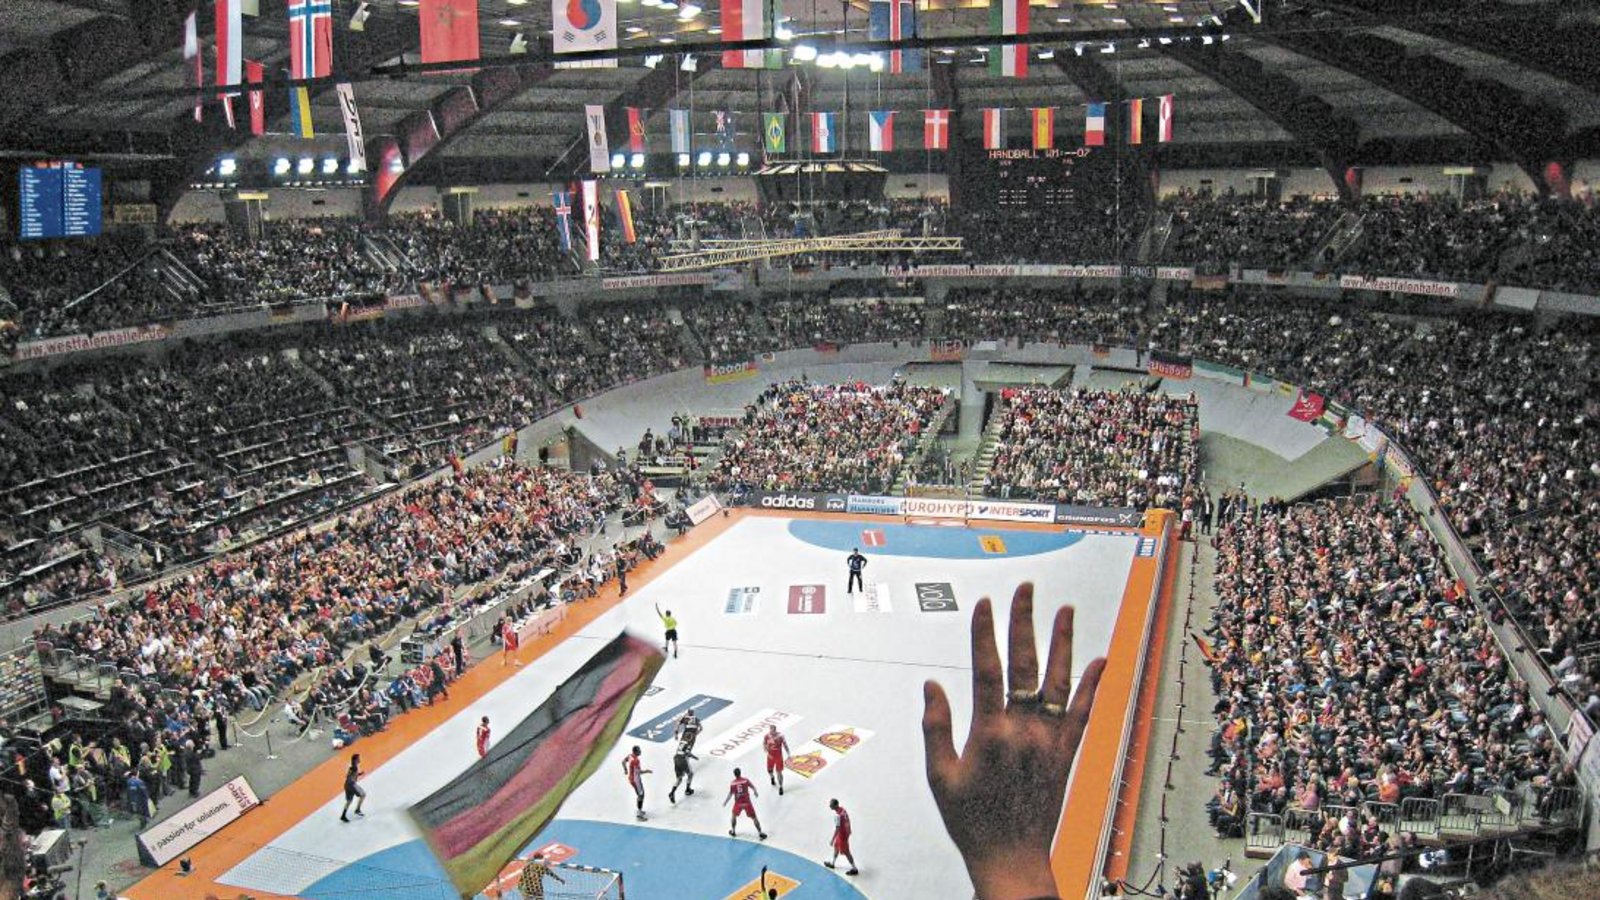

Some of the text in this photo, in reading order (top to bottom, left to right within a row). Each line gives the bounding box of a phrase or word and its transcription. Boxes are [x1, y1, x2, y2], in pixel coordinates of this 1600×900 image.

[762, 494, 815, 509] adidas
[989, 506, 1050, 518] INTERSPORT
[156, 828, 185, 849] passion
[184, 820, 196, 831] for
